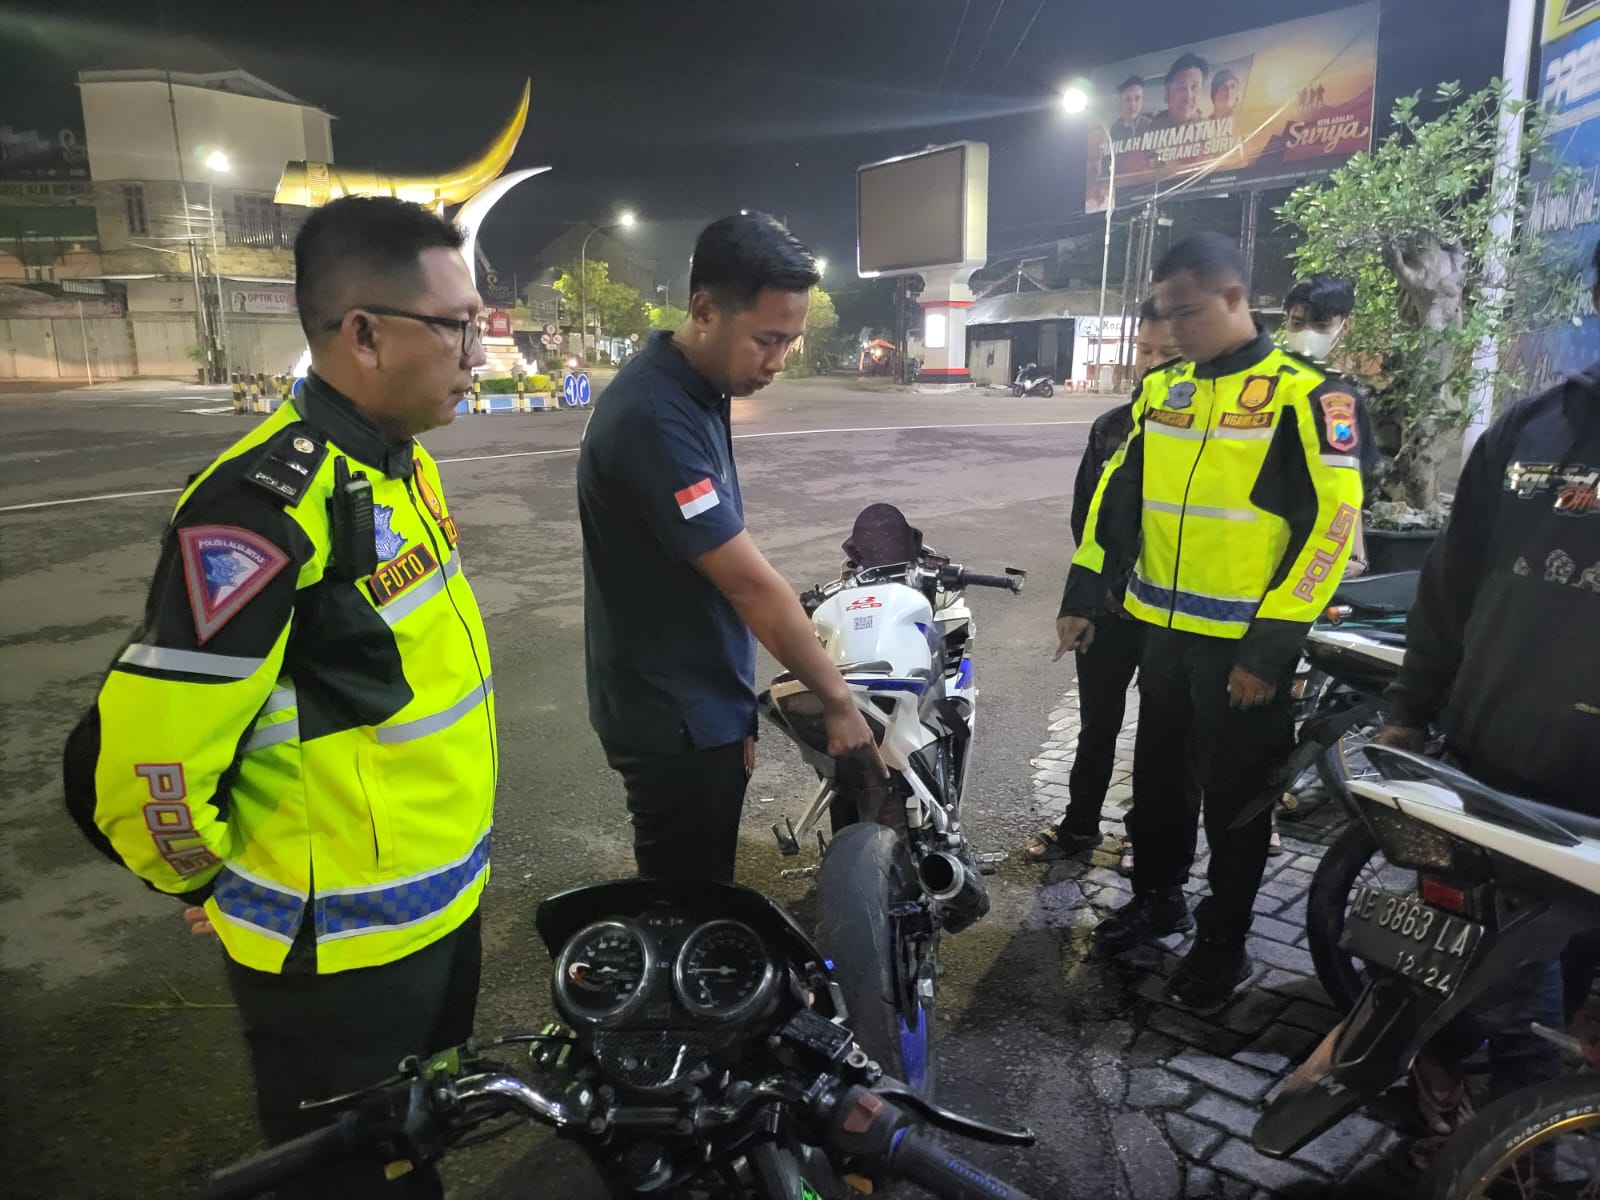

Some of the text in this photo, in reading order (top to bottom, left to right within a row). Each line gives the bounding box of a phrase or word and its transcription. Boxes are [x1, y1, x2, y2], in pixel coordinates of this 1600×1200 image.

[1142, 117, 1234, 151] NIKMATNYA
[1157, 135, 1245, 162] TERANG SURYA
[1286, 120, 1369, 154] Surya
[1291, 501, 1358, 604] POLISI
[379, 553, 425, 597] FUTO
[1352, 887, 1473, 957] AE 3863 LA
